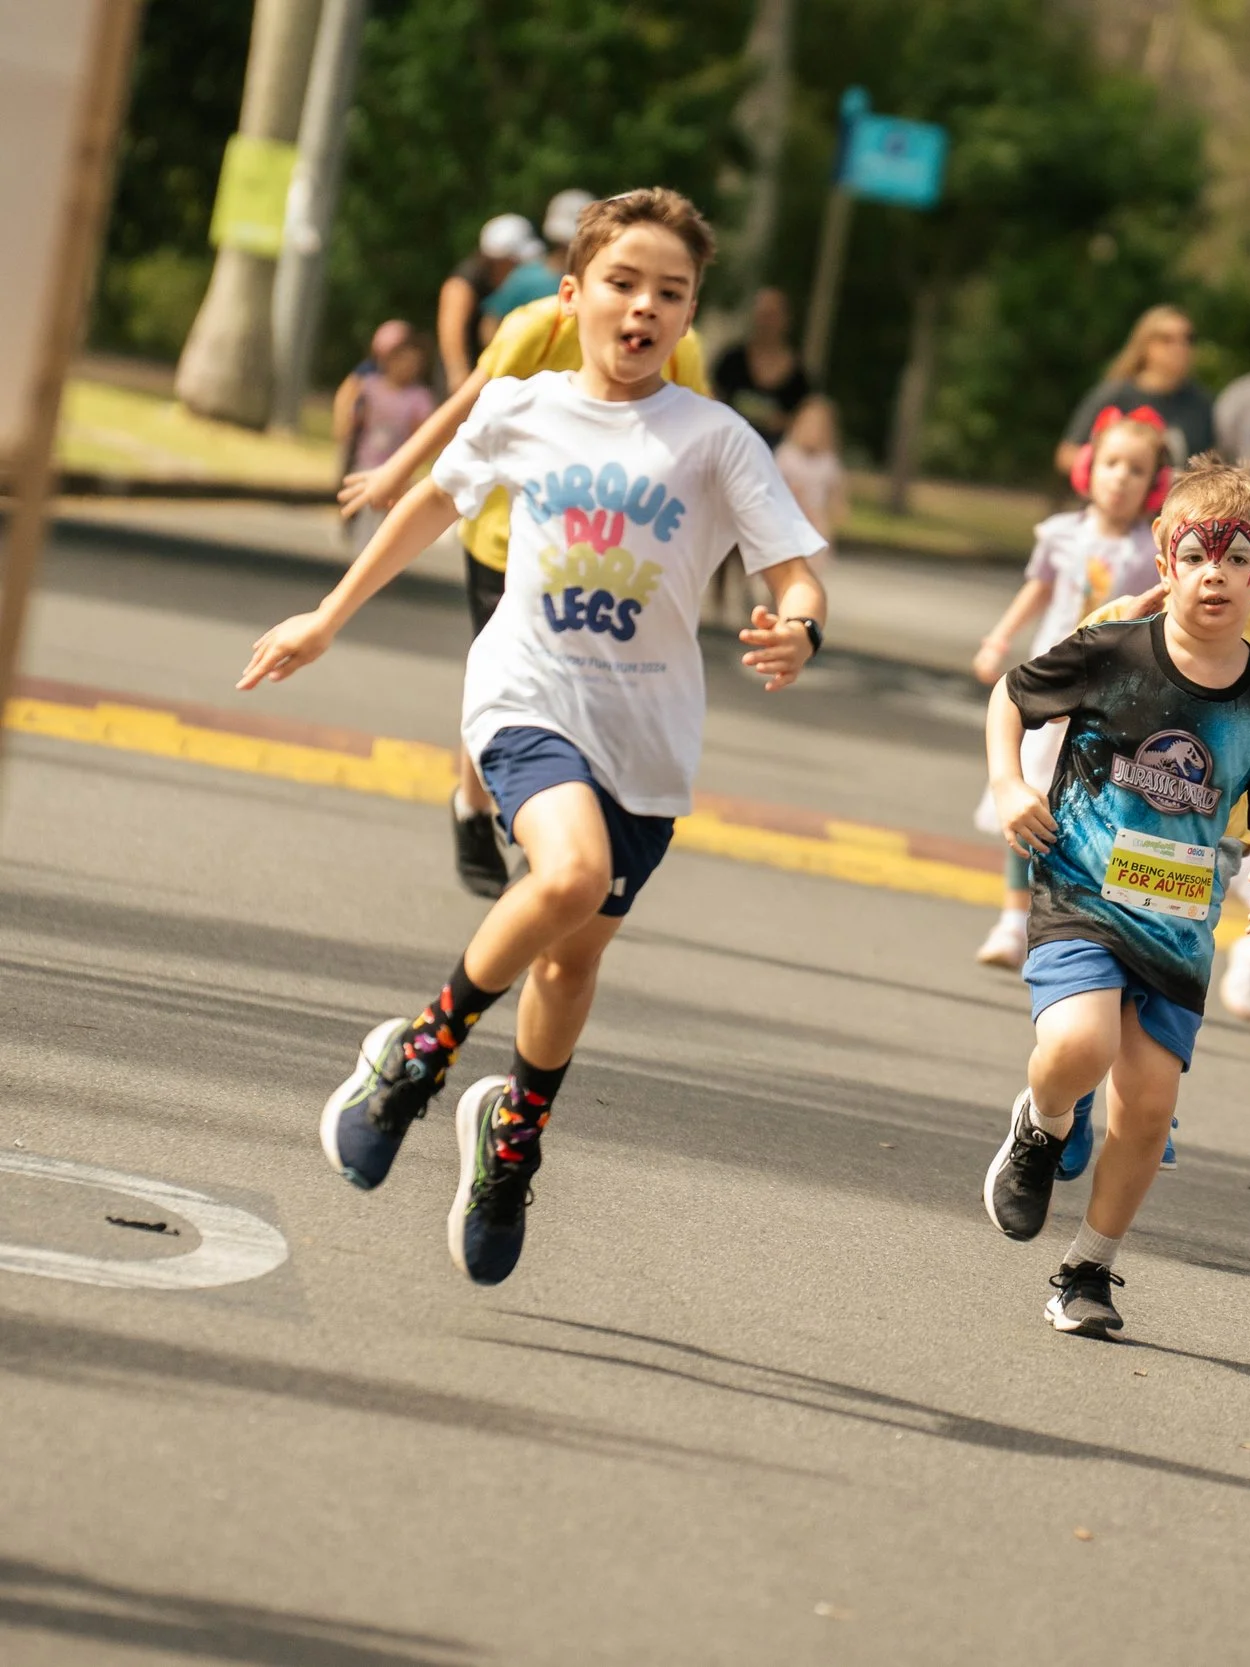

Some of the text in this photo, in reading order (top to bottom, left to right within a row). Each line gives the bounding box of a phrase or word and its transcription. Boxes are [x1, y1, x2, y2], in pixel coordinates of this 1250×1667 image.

[522, 462, 686, 543] CIRQUE
[565, 507, 625, 556] DU
[543, 587, 642, 641] LEGS
[1115, 760, 1216, 810] JURASSIC WORLD
[1112, 857, 1212, 887] I'M BEING AWESOME
[1117, 869, 1205, 898] FOR AUTISM
